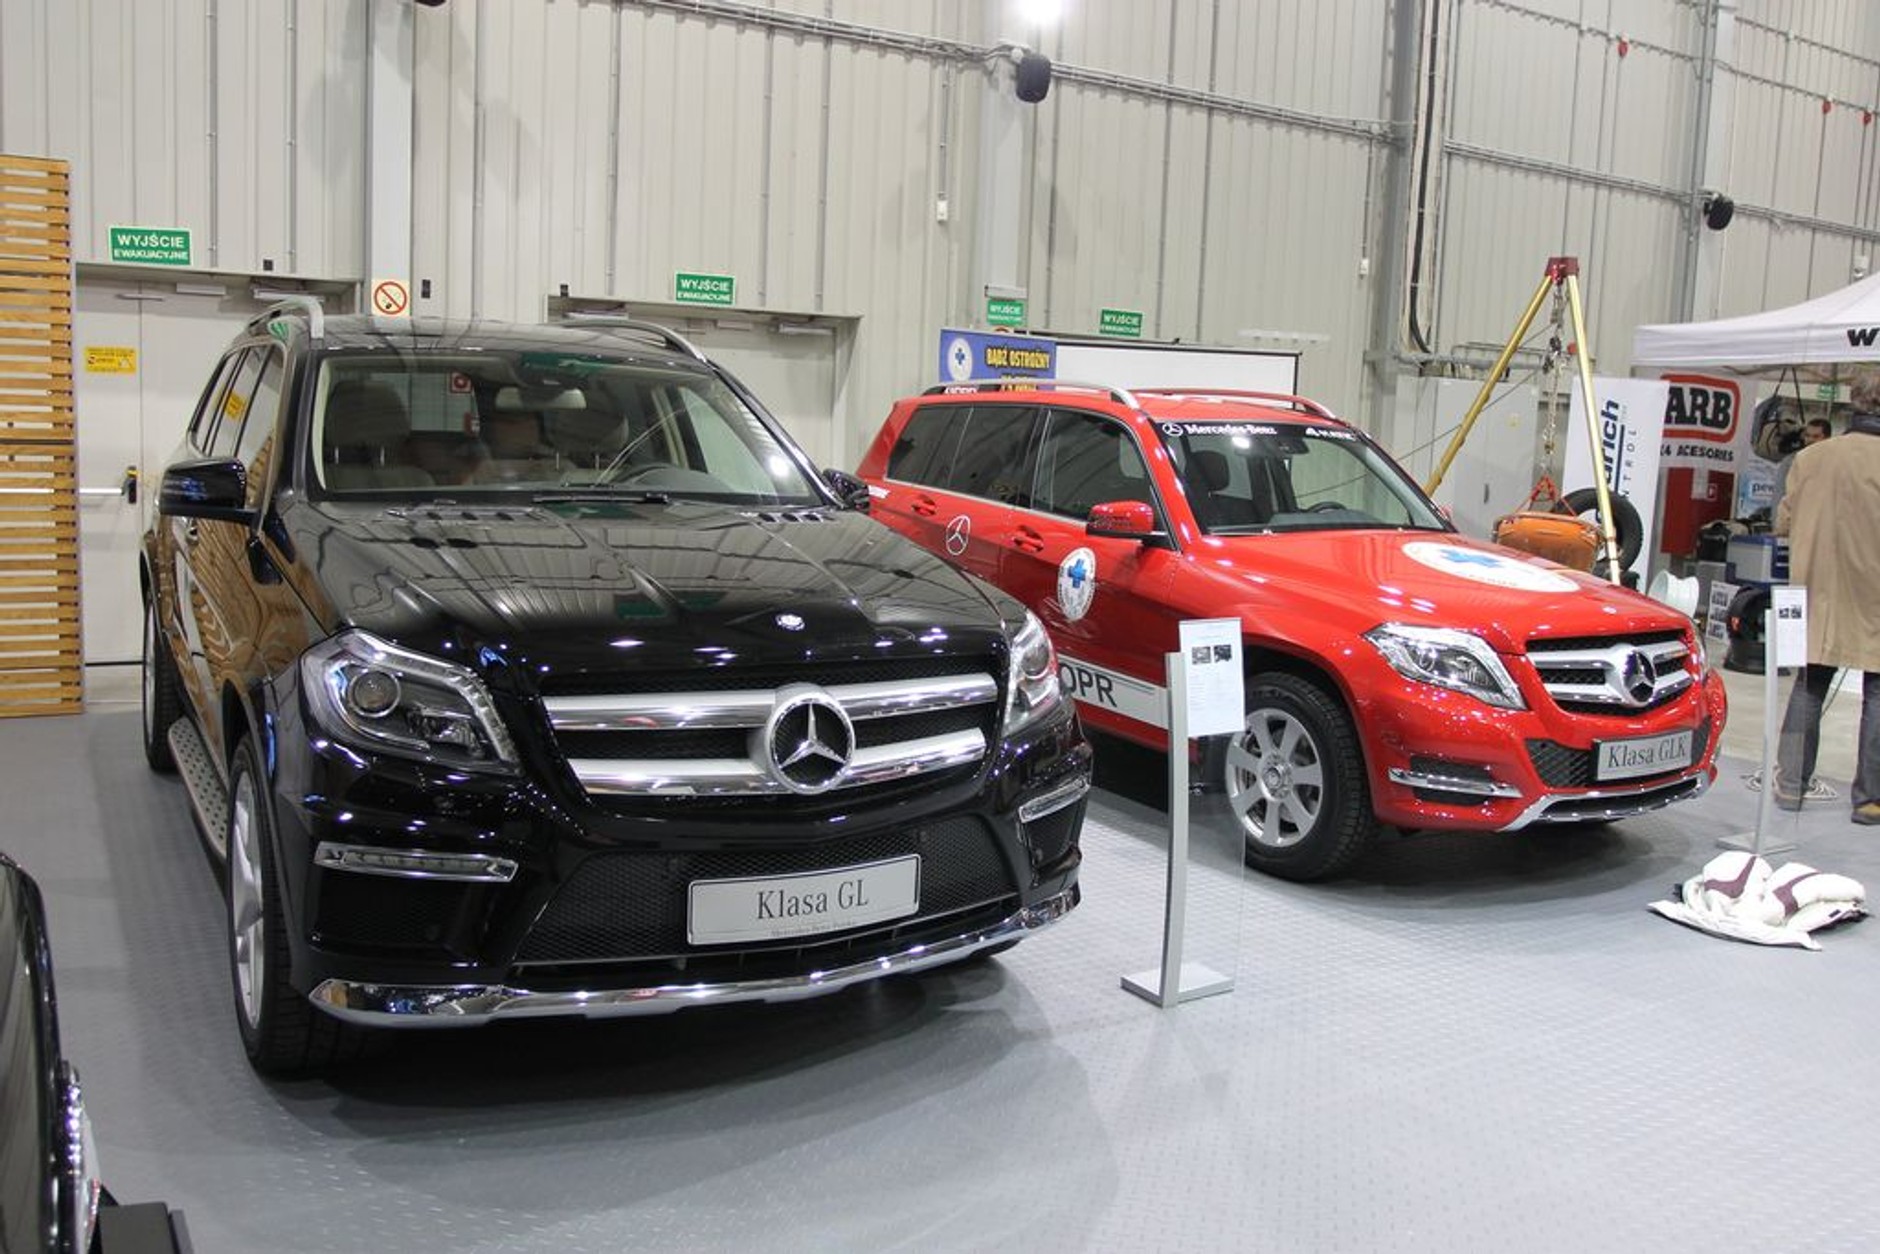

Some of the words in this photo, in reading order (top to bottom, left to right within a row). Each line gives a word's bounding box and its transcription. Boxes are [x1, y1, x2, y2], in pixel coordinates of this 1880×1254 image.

[117, 232, 185, 249] WYJŚCIE
[680, 278, 731, 292] WYJŚCIE
[1664, 386, 1732, 429] ARB
[1184, 423, 1278, 436] Mercedes-Benz
[1676, 444, 1734, 462] ACESORIES
[1608, 744, 1654, 768] Klasa
[1659, 734, 1687, 761] GLK
[757, 889, 829, 920] Klasa
[837, 879, 869, 910] GL
